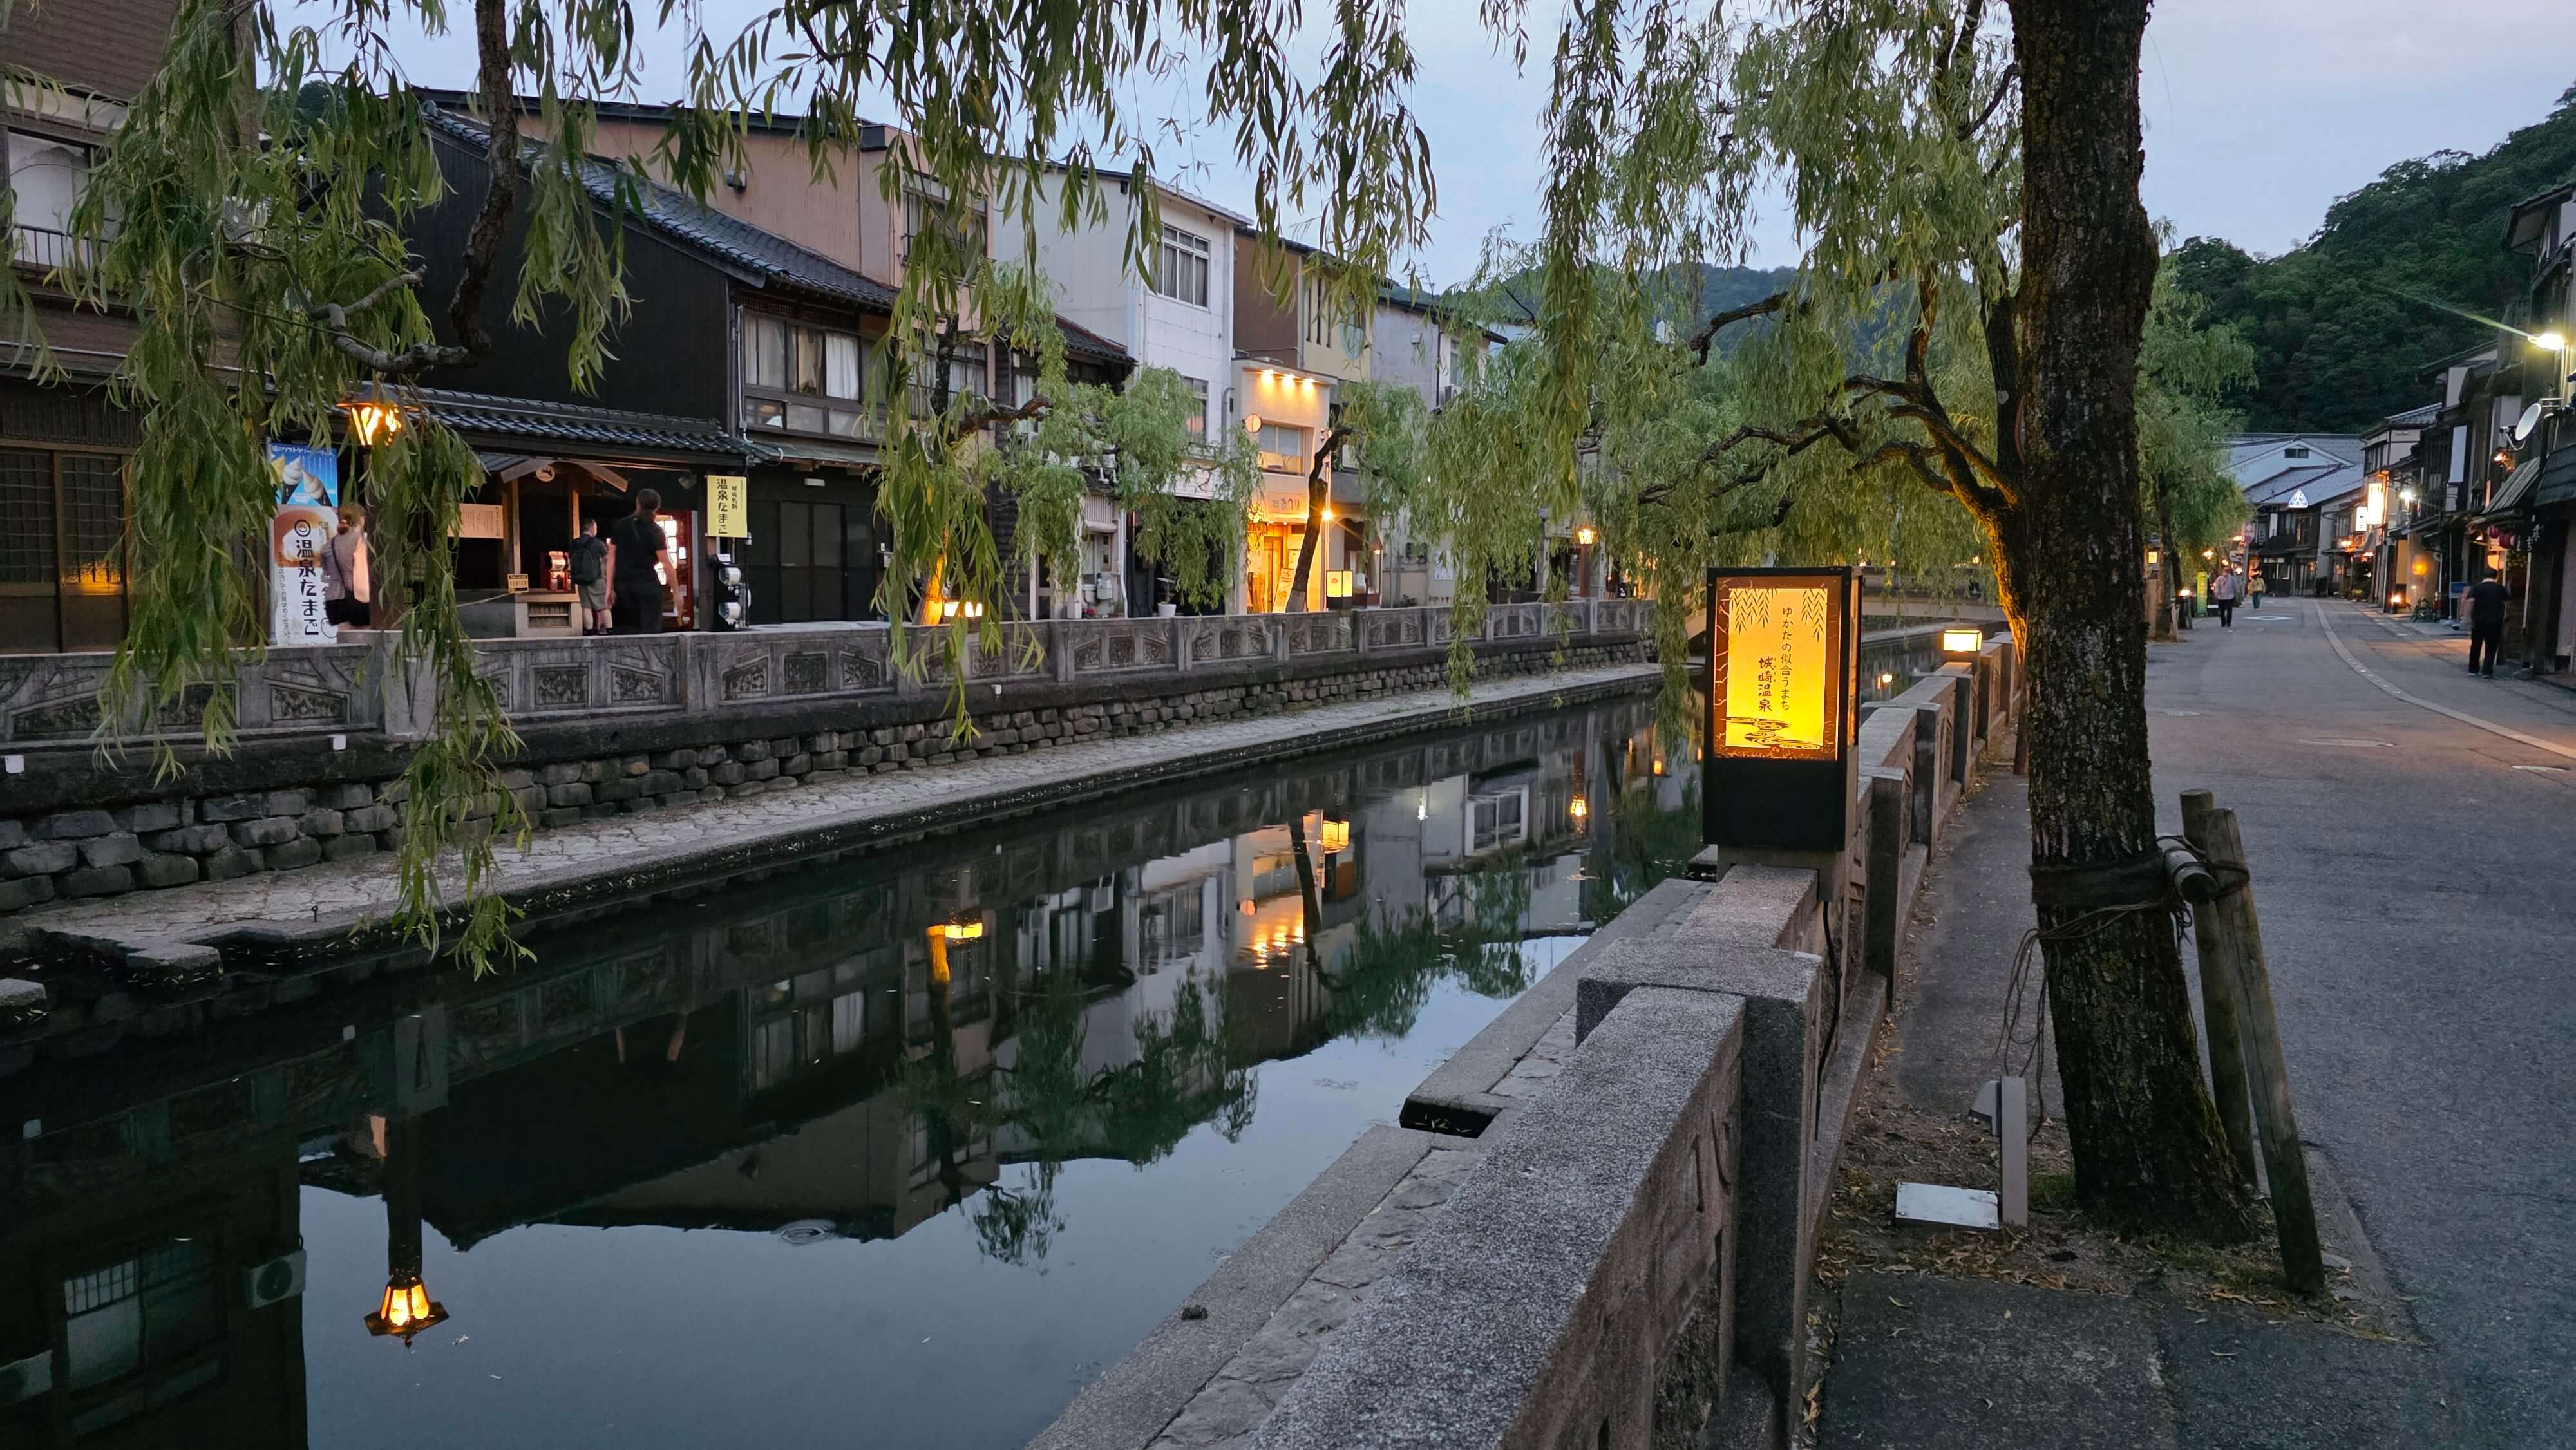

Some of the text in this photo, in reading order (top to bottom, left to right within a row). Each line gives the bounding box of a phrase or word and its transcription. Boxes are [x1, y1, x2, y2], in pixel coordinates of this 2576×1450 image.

[717, 478, 728, 534] 温泉たまご
[296, 540, 319, 636] 温泉たまご
[1758, 655, 1774, 712] 城崎温泉
[1779, 606, 1794, 711] ゆかたの似合うまち
